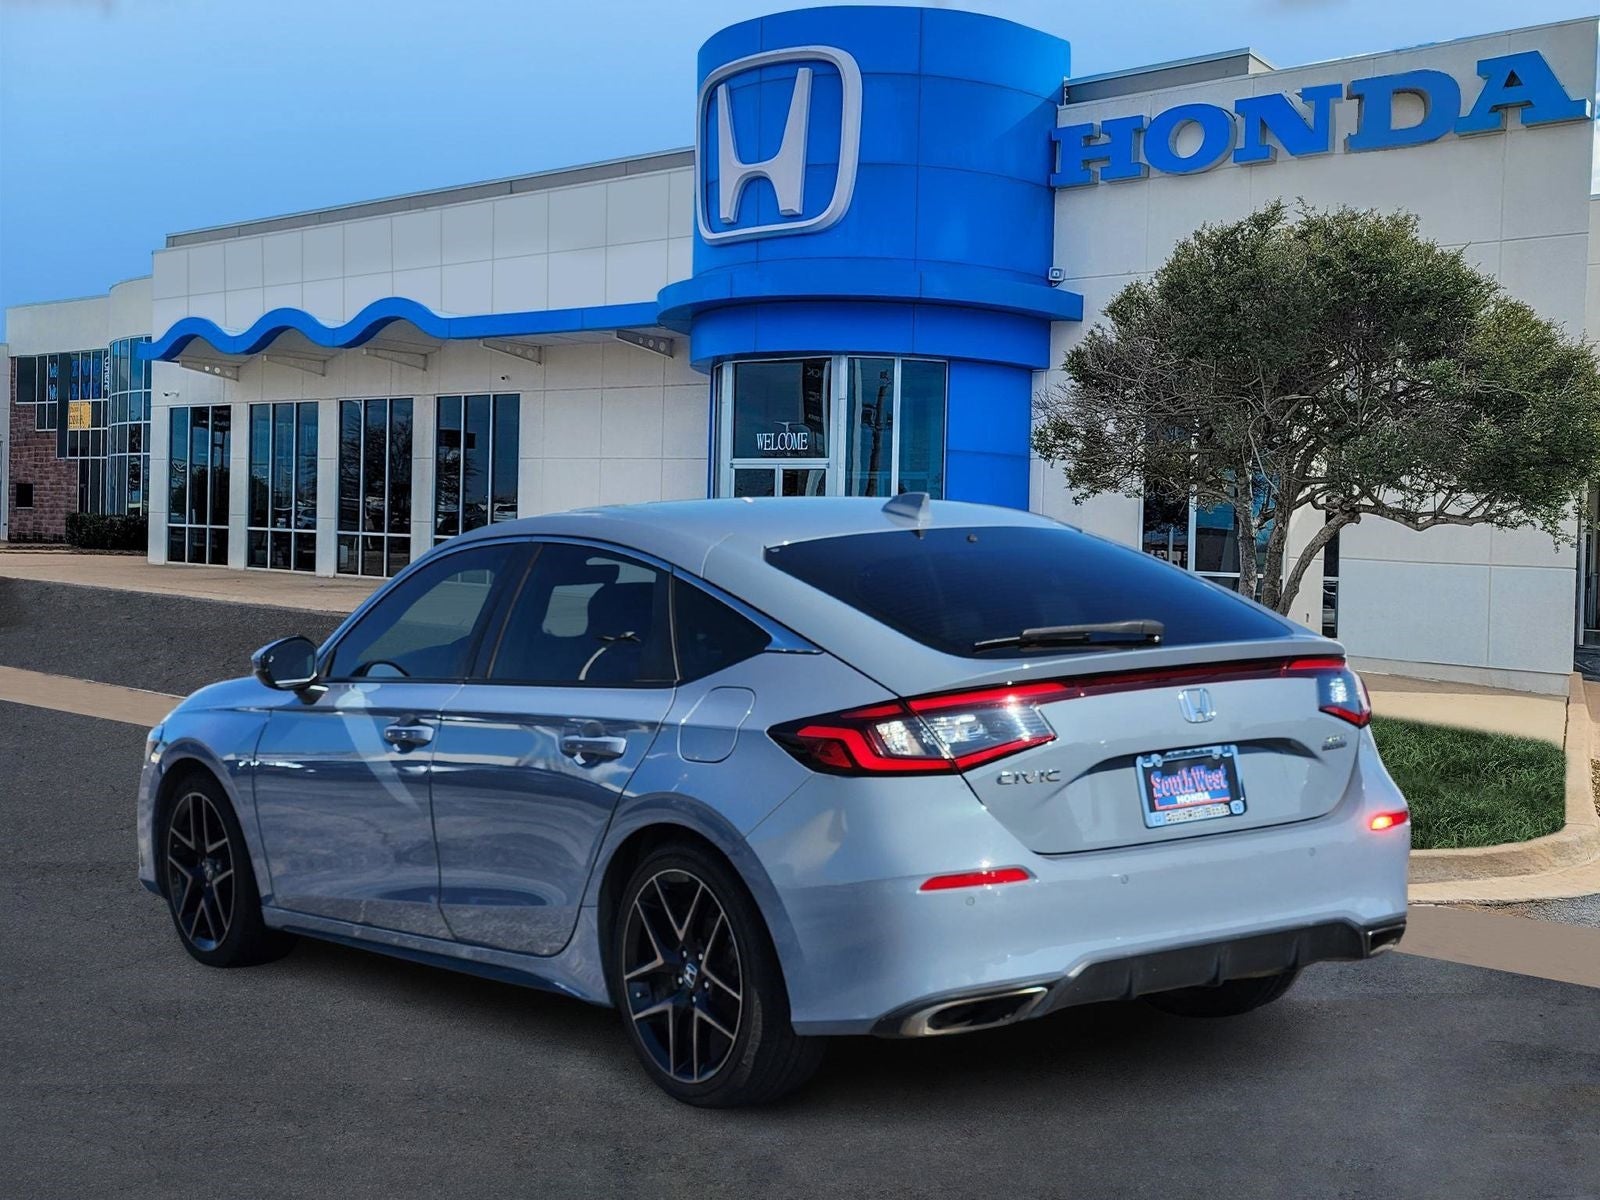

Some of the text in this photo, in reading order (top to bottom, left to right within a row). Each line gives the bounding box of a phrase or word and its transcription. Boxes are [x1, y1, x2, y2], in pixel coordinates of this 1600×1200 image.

[1050, 50, 1592, 188] HONDA
[756, 432, 808, 451] WELCOME
[997, 769, 1060, 785] CIVIC
[1150, 763, 1228, 798] SouthWest
[1176, 792, 1211, 804] HONDA
